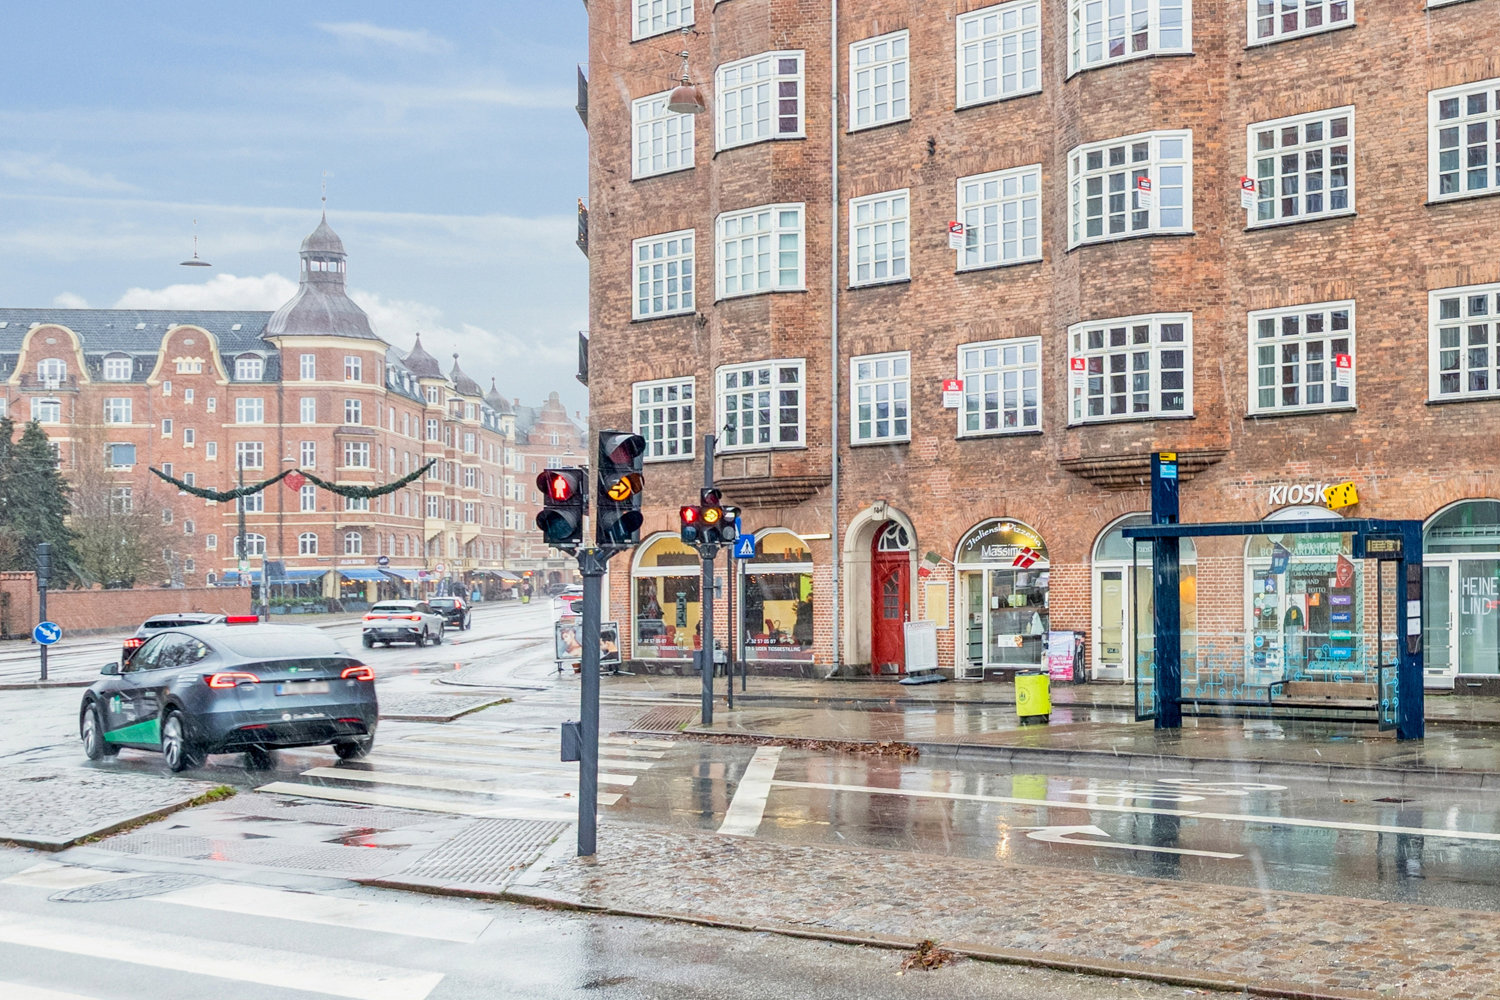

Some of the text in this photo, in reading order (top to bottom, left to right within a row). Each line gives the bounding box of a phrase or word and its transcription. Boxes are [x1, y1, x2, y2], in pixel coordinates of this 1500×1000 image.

[1268, 483, 1330, 505] KIOSK
[965, 522, 1041, 550] Italiensk Pizzeria
[1462, 577, 1499, 596] HEINE
[1462, 597, 1492, 616] LIND
